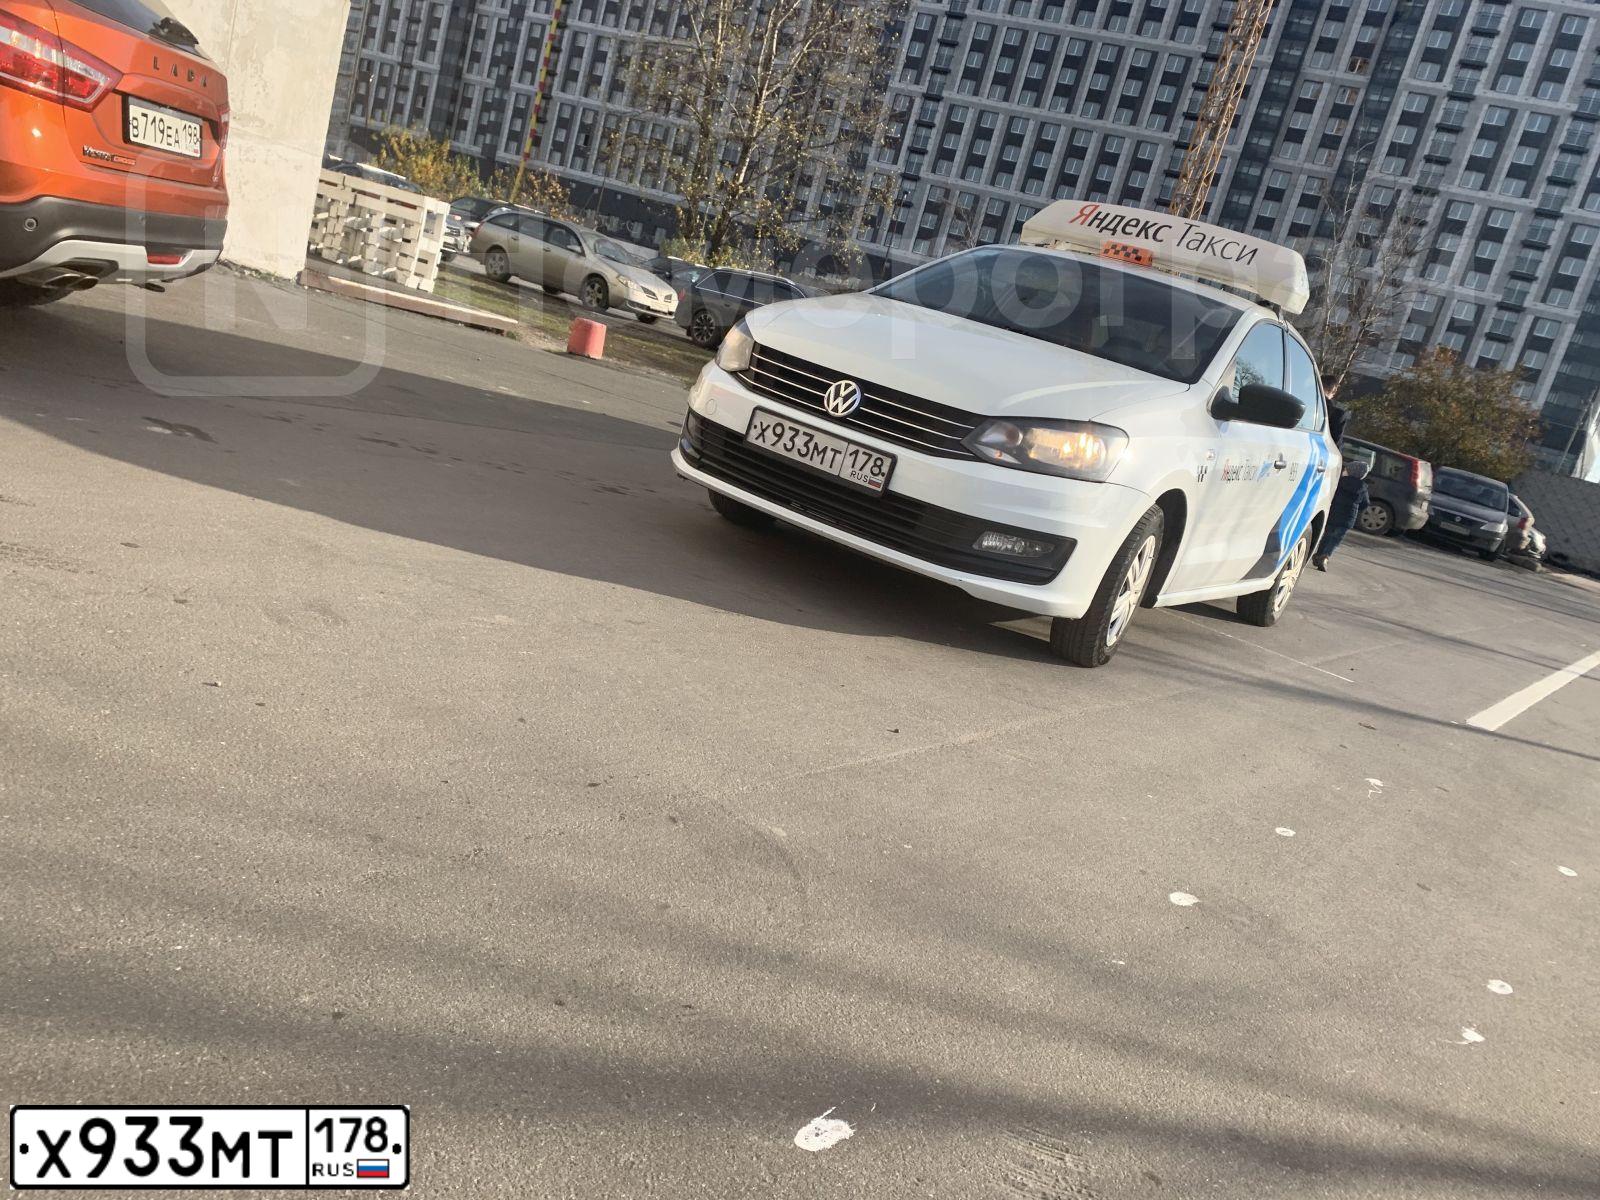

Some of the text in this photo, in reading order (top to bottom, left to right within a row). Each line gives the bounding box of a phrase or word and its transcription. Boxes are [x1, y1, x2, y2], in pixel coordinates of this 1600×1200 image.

[1069, 204, 1259, 266] Яндекс Такси
[850, 449, 884, 477] 178
[850, 470, 869, 483] RUS
